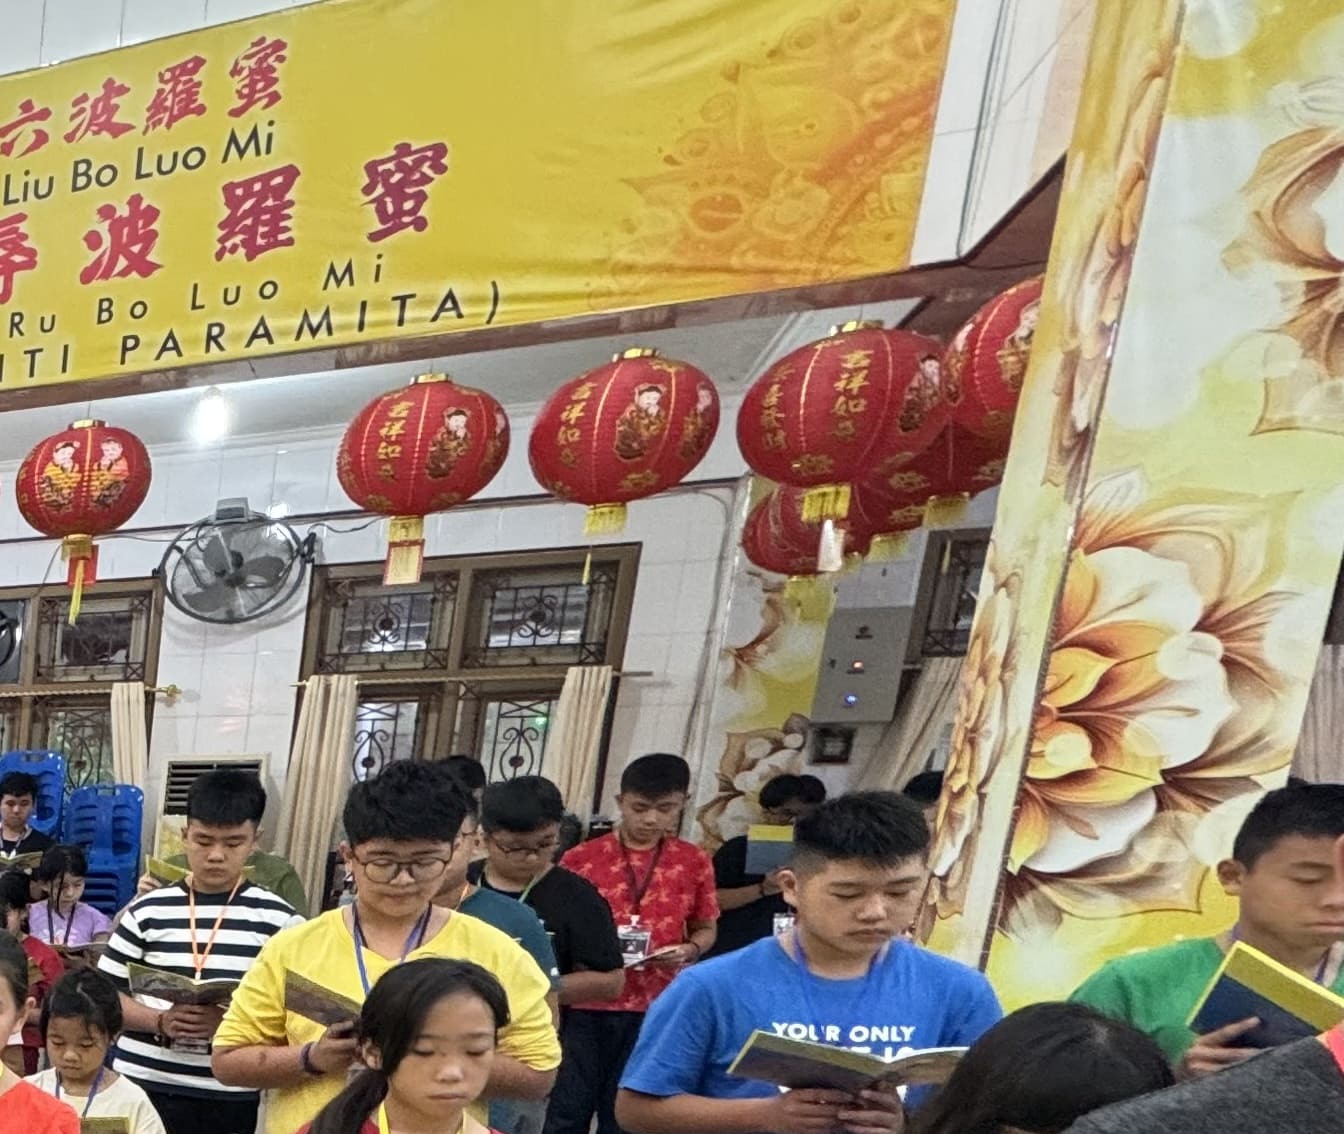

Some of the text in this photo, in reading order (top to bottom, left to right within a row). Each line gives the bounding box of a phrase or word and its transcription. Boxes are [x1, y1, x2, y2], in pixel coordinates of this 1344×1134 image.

[3, 119, 275, 206] Liu Bo Luo Mi
[8, 311, 57, 338] Ru
[96, 297, 148, 325] Bo
[190, 279, 279, 311] Luo
[321, 253, 383, 291] Mi
[119, 280, 501, 366] PARAMITA)
[849, 1026, 916, 1042] ONLY
